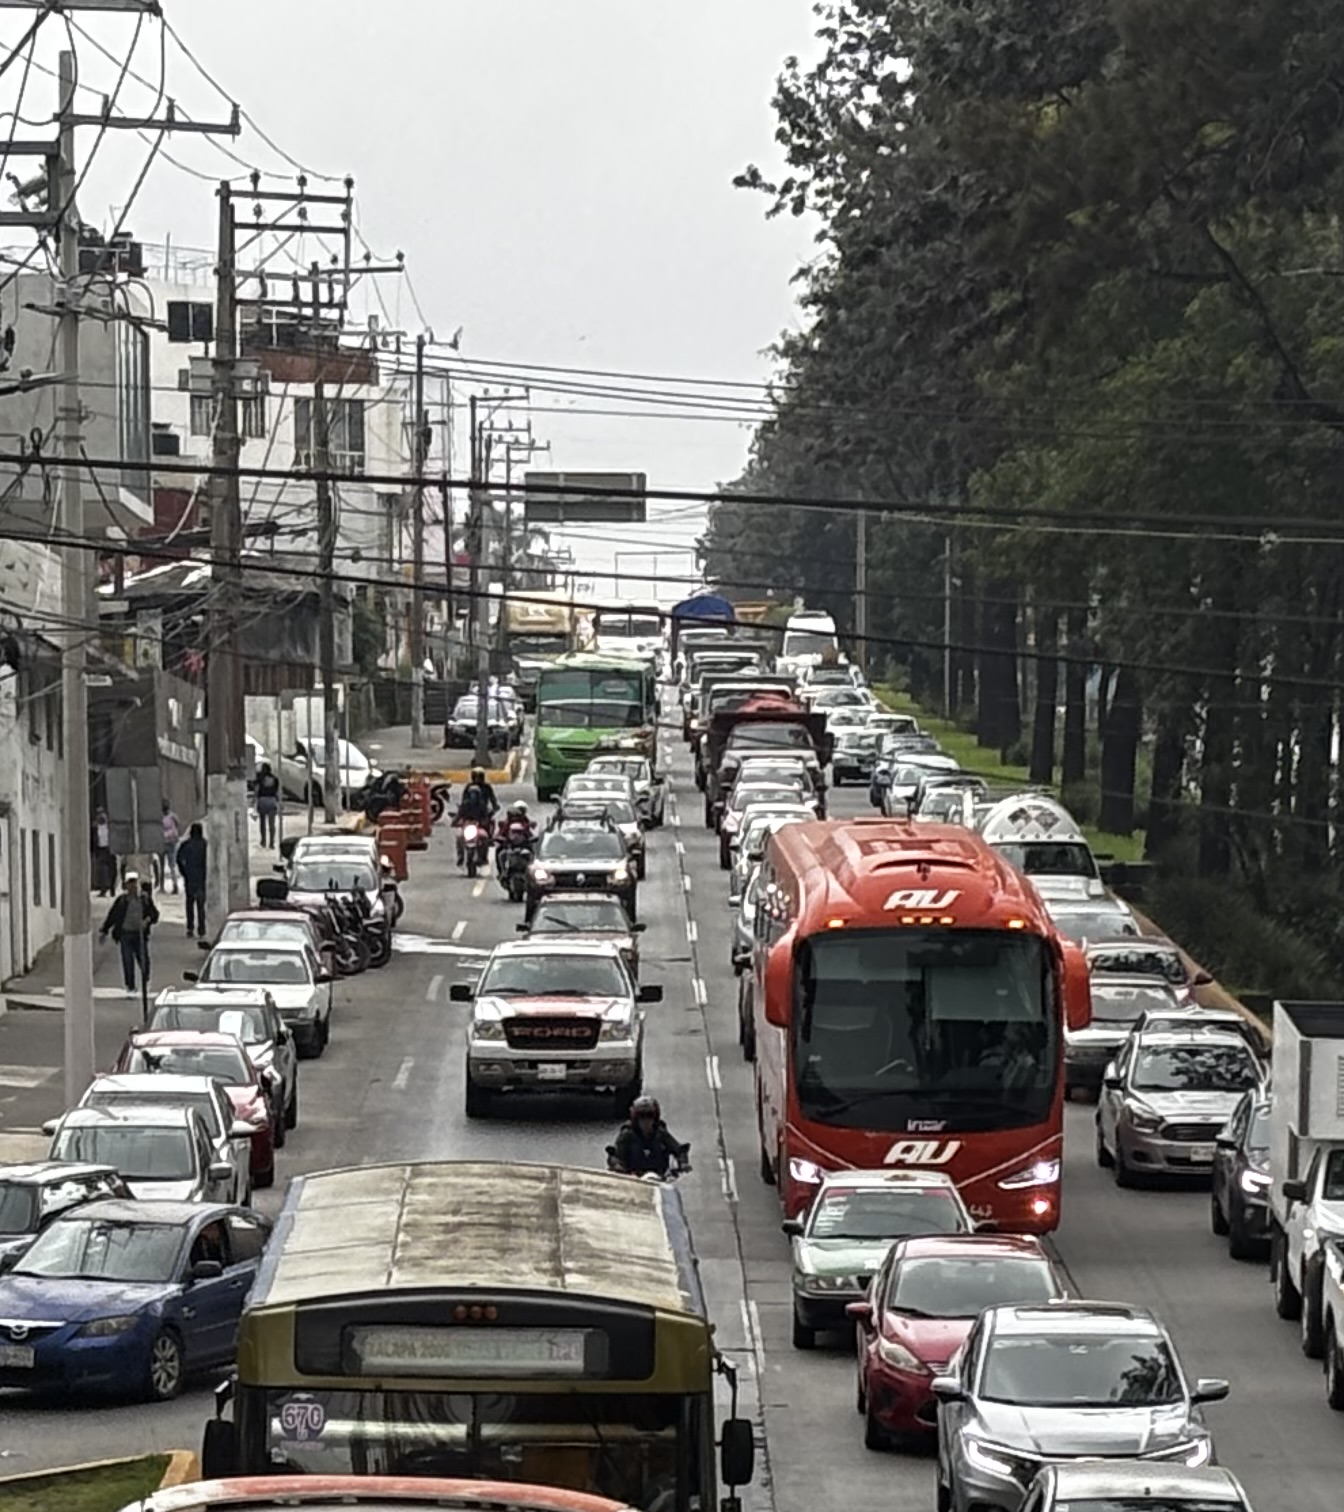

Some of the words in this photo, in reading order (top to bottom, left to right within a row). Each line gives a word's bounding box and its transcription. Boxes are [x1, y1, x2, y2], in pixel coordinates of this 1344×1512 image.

[883, 889, 961, 911] AU
[883, 1140, 962, 1164] AU
[282, 1404, 324, 1430] 670
